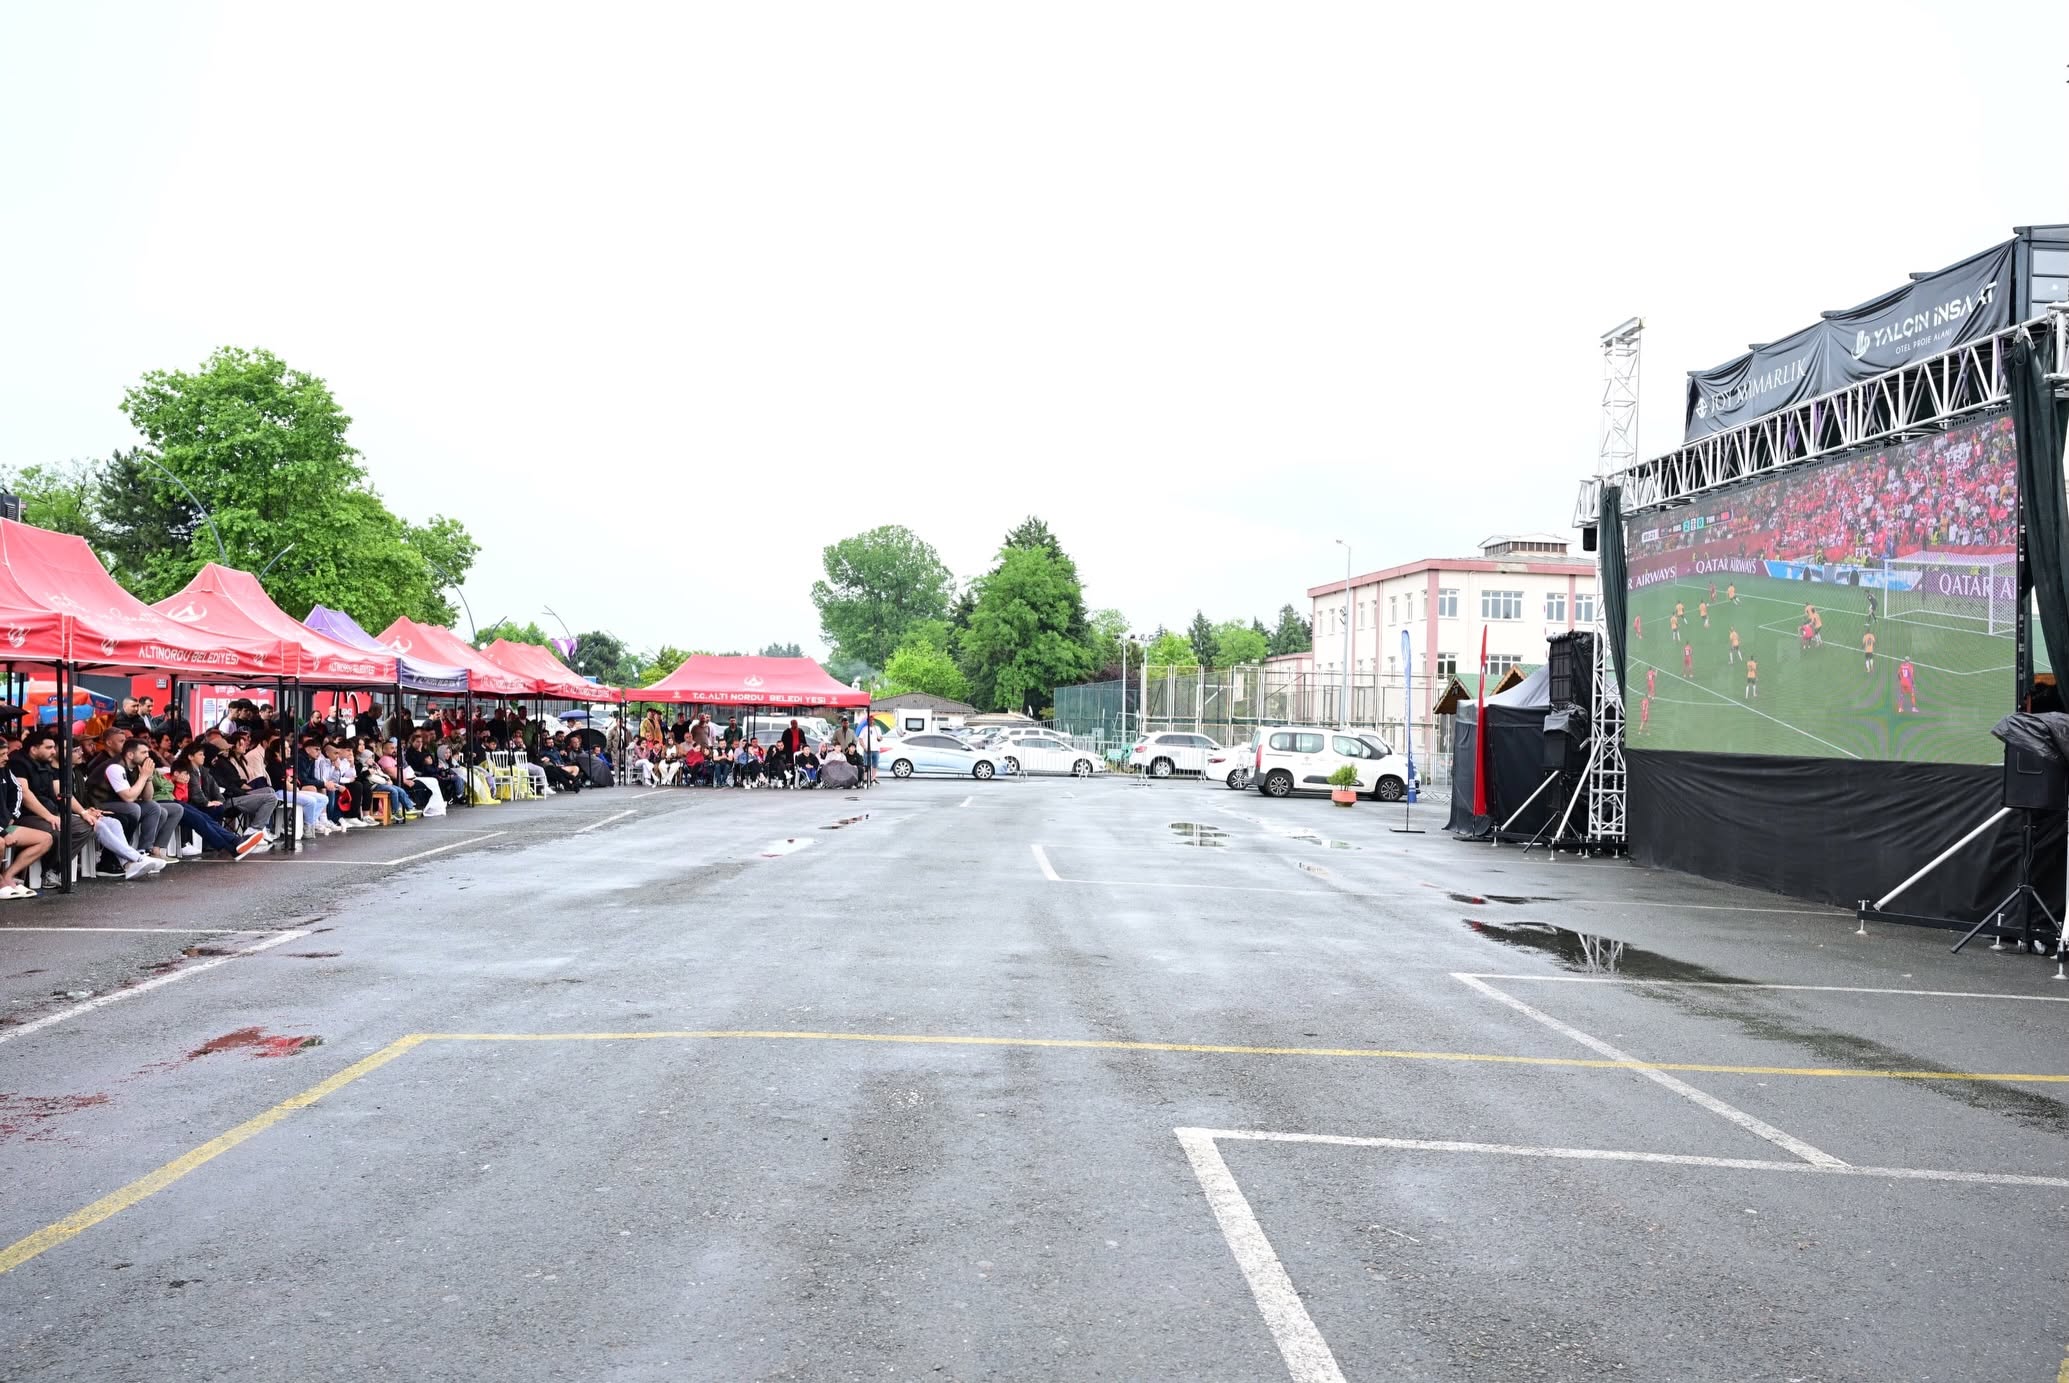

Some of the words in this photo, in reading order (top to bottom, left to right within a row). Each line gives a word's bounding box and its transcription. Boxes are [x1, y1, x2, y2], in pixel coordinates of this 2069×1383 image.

[1895, 343, 1911, 355] OTEL
[1913, 335, 1932, 349] PROJE
[1711, 387, 1734, 416] JOY
[1636, 566, 1676, 588] AIRWAYS
[1695, 559, 1728, 574] QATAR
[1729, 559, 1757, 575] AIRWAYS
[1939, 573, 1990, 598] QATAR
[138, 645, 192, 662] ALTINORDU
